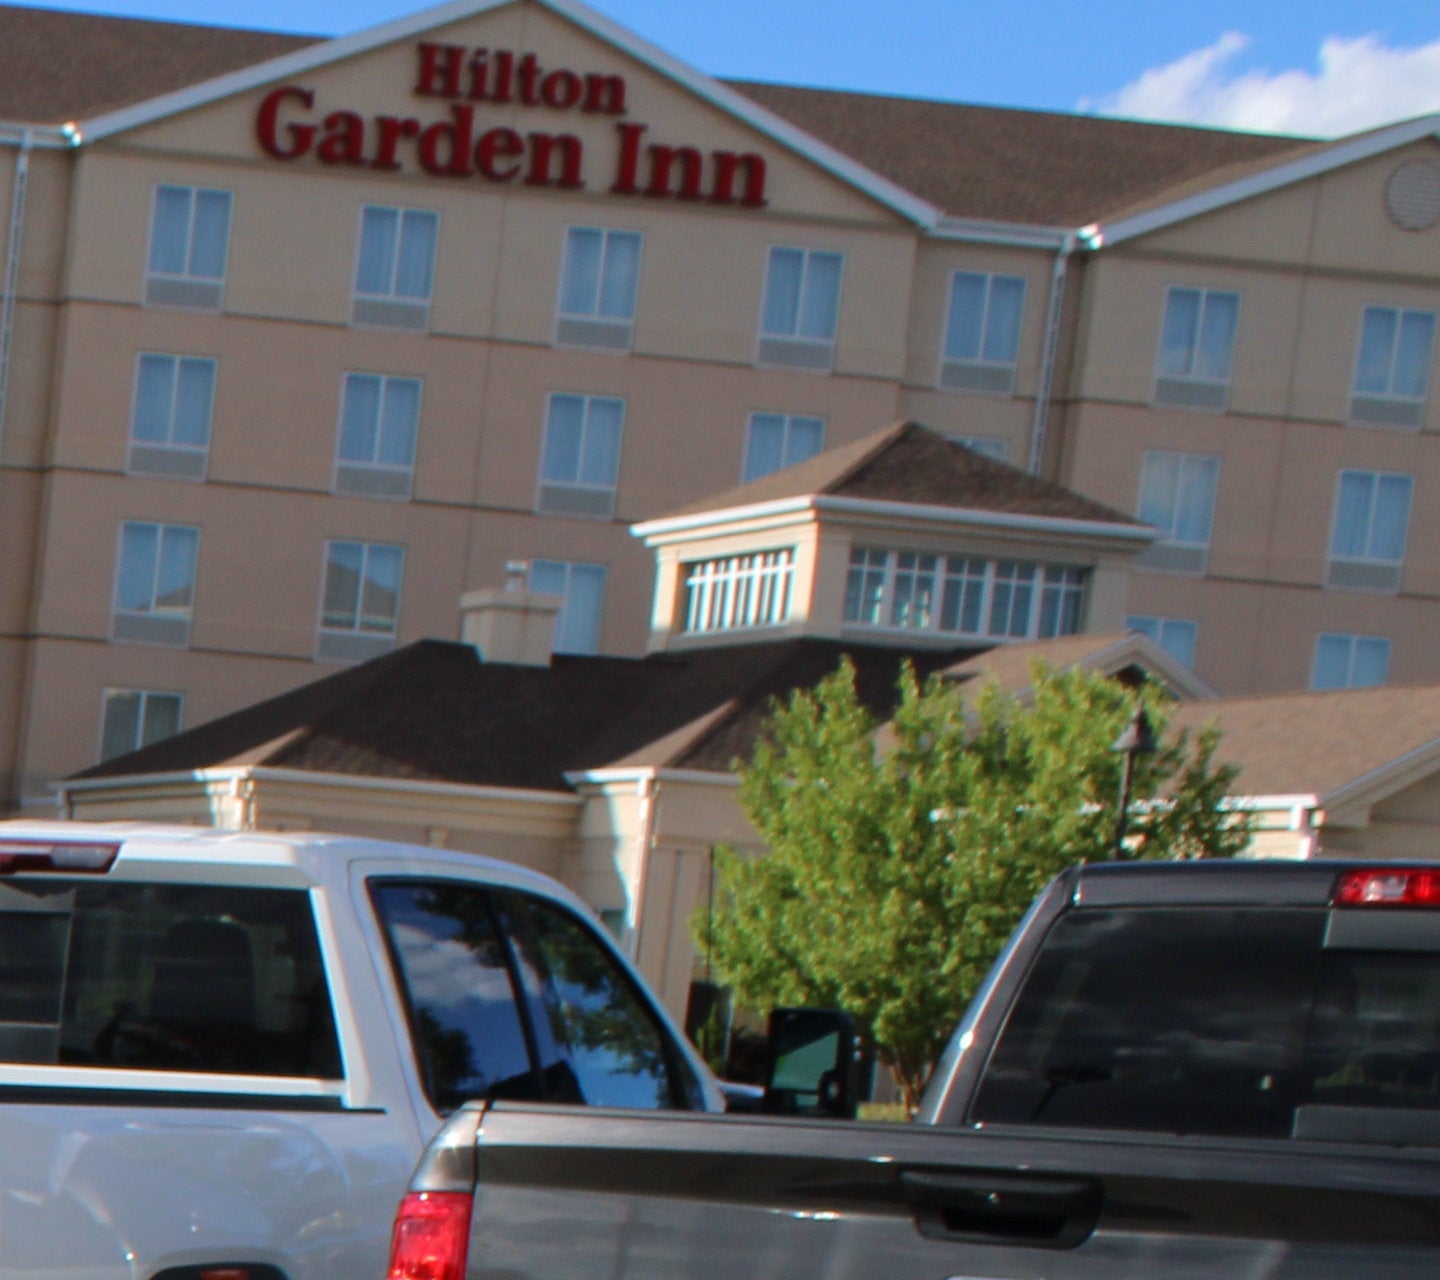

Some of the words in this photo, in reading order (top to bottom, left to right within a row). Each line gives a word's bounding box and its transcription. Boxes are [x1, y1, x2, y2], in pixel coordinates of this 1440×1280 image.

[415, 42, 627, 115] Hilton
[256, 86, 585, 189] Garden
[610, 122, 768, 208] Inn
